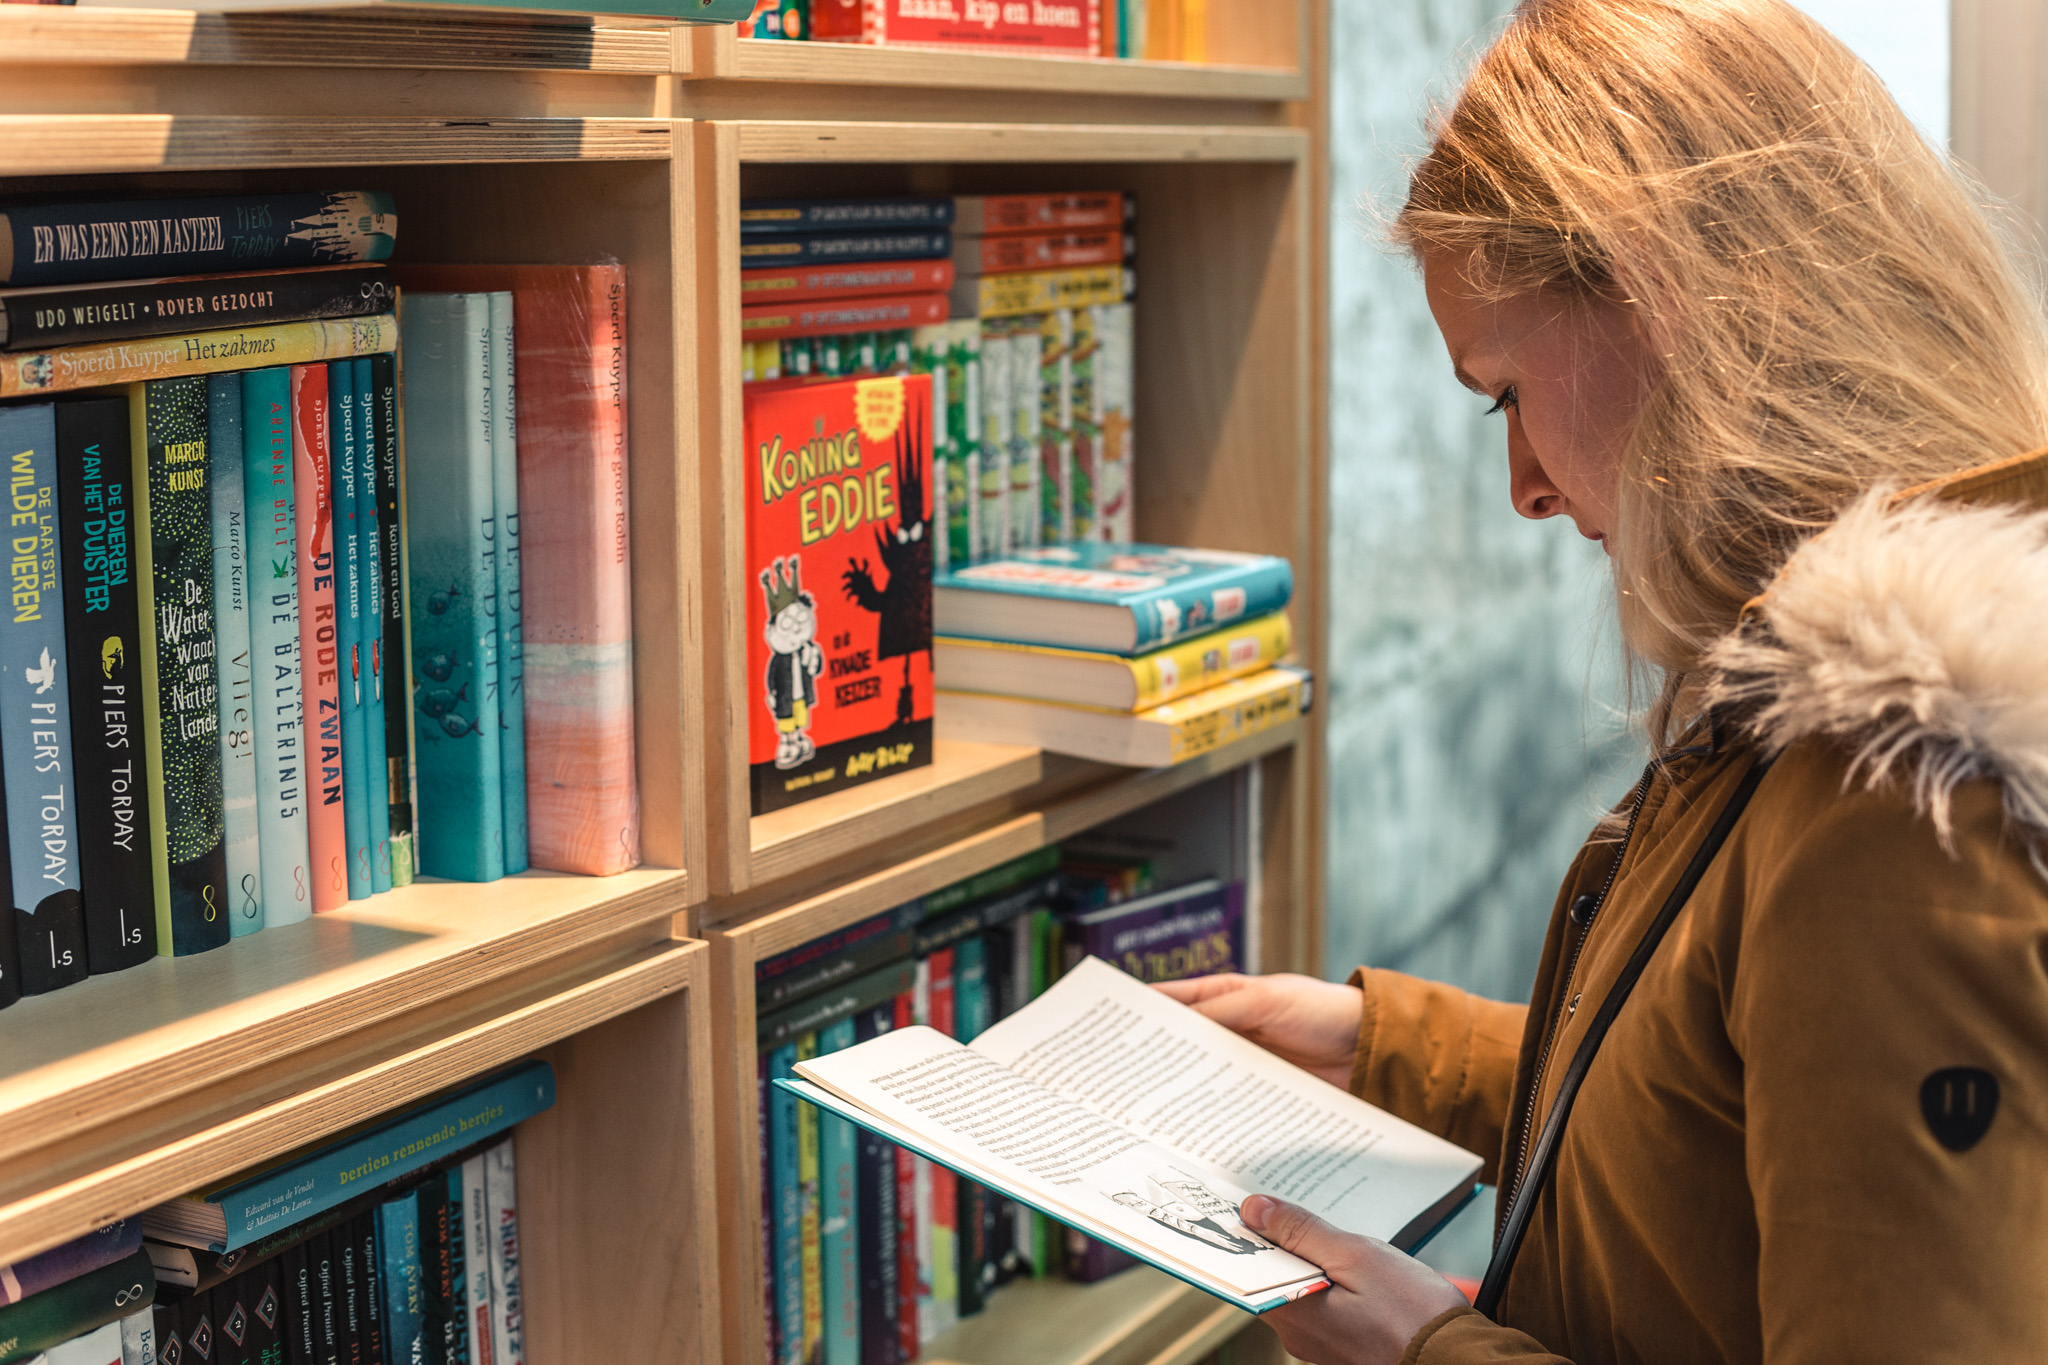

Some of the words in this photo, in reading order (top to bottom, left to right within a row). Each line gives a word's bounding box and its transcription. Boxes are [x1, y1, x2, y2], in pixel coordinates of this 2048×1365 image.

[33, 226, 54, 263] ER
[55, 222, 89, 260] WAS
[90, 220, 128, 259] EENS
[130, 219, 160, 257] EEN
[162, 216, 225, 255] KASTEEL
[236, 204, 273, 231] PIERS
[231, 234, 279, 259] TORDAY
[35, 309, 66, 329] UDO
[73, 303, 136, 326] WEIGELT
[157, 297, 204, 317] ROVER
[211, 291, 274, 312] GEZOCHT
[608, 283, 621, 340] Sjoerd
[60, 350, 115, 382] Sjoerd
[117, 344, 181, 374] Kuyper
[183, 338, 217, 362] Het
[219, 334, 275, 358] zakmes
[480, 327, 490, 380] Sjoerd
[609, 345, 621, 410] Kuyper
[314, 399, 323, 450] SJOERD
[340, 395, 354, 443] Sjoerd
[361, 393, 374, 440] Sjoerd
[382, 386, 395, 434] Sjoerd
[480, 386, 490, 444] Kuyper
[82, 444, 102, 481] VAN
[165, 441, 205, 464] MARCO
[270, 401, 285, 487] ARIENNE
[384, 436, 395, 488] Kuyper
[614, 432, 623, 455] De
[760, 428, 861, 504] KONING
[10, 449, 37, 526] WILDE
[169, 468, 204, 492] KUNST
[317, 455, 325, 509] KUYPER
[342, 446, 355, 499] Kuyper
[363, 443, 375, 495] Kuyper
[611, 461, 623, 507] grote
[38, 486, 51, 508] DE
[84, 483, 104, 513] HET
[108, 484, 122, 506] DE
[799, 463, 897, 546] EDDIE
[230, 511, 241, 560] Marco
[274, 499, 288, 546] BOLT
[369, 531, 377, 559] Het
[389, 524, 398, 566] Robin
[481, 517, 495, 571] DE
[506, 513, 519, 567] DE
[615, 511, 625, 564] Robin
[40, 515, 56, 590] LAATSTE
[83, 519, 110, 614] DUISTER
[108, 509, 128, 586] DIEREN
[313, 551, 332, 592] DE
[348, 534, 357, 562] Het
[12, 536, 42, 623] DIEREN
[185, 579, 202, 607] De
[232, 565, 243, 611] Kunst
[349, 564, 359, 619] zakmes
[370, 560, 379, 615] zakmes
[391, 570, 398, 587] en
[272, 593, 291, 624] DE
[391, 589, 401, 619] God
[315, 603, 336, 686] RODE
[187, 663, 210, 683] van
[102, 685, 129, 748] PIERS
[228, 650, 253, 759] Vlieg!
[30, 702, 60, 773] PIERS
[274, 642, 298, 820] BALLERINUS
[319, 697, 341, 806] ZWAAN
[111, 759, 135, 852] TORDAY
[40, 784, 67, 886] TORDAY
[340, 1153, 390, 1185] Dertien
[393, 1123, 457, 1161] rennende
[459, 1104, 504, 1135] hertjes
[245, 1196, 271, 1218] Edward
[271, 1194, 285, 1206] van
[285, 1189, 294, 1202] de
[293, 1178, 315, 1199] Vendel
[246, 1219, 255, 1231] &
[255, 1208, 281, 1229] Mattias
[281, 1203, 292, 1217] De
[404, 1220, 415, 1258] TOM
[438, 1205, 446, 1243] TOM
[406, 1264, 418, 1314] AVERY
[440, 1249, 451, 1298] AVERY
[235, 1320, 241, 1329] 2
[267, 1303, 273, 1312] 2
[323, 1301, 335, 1345] Preussler
[347, 1289, 357, 1331] Preussler
[172, 1349, 176, 1358] 1
[202, 1334, 207, 1342] 1
[302, 1310, 312, 1354] Preussler
[444, 1320, 454, 1344] DE
